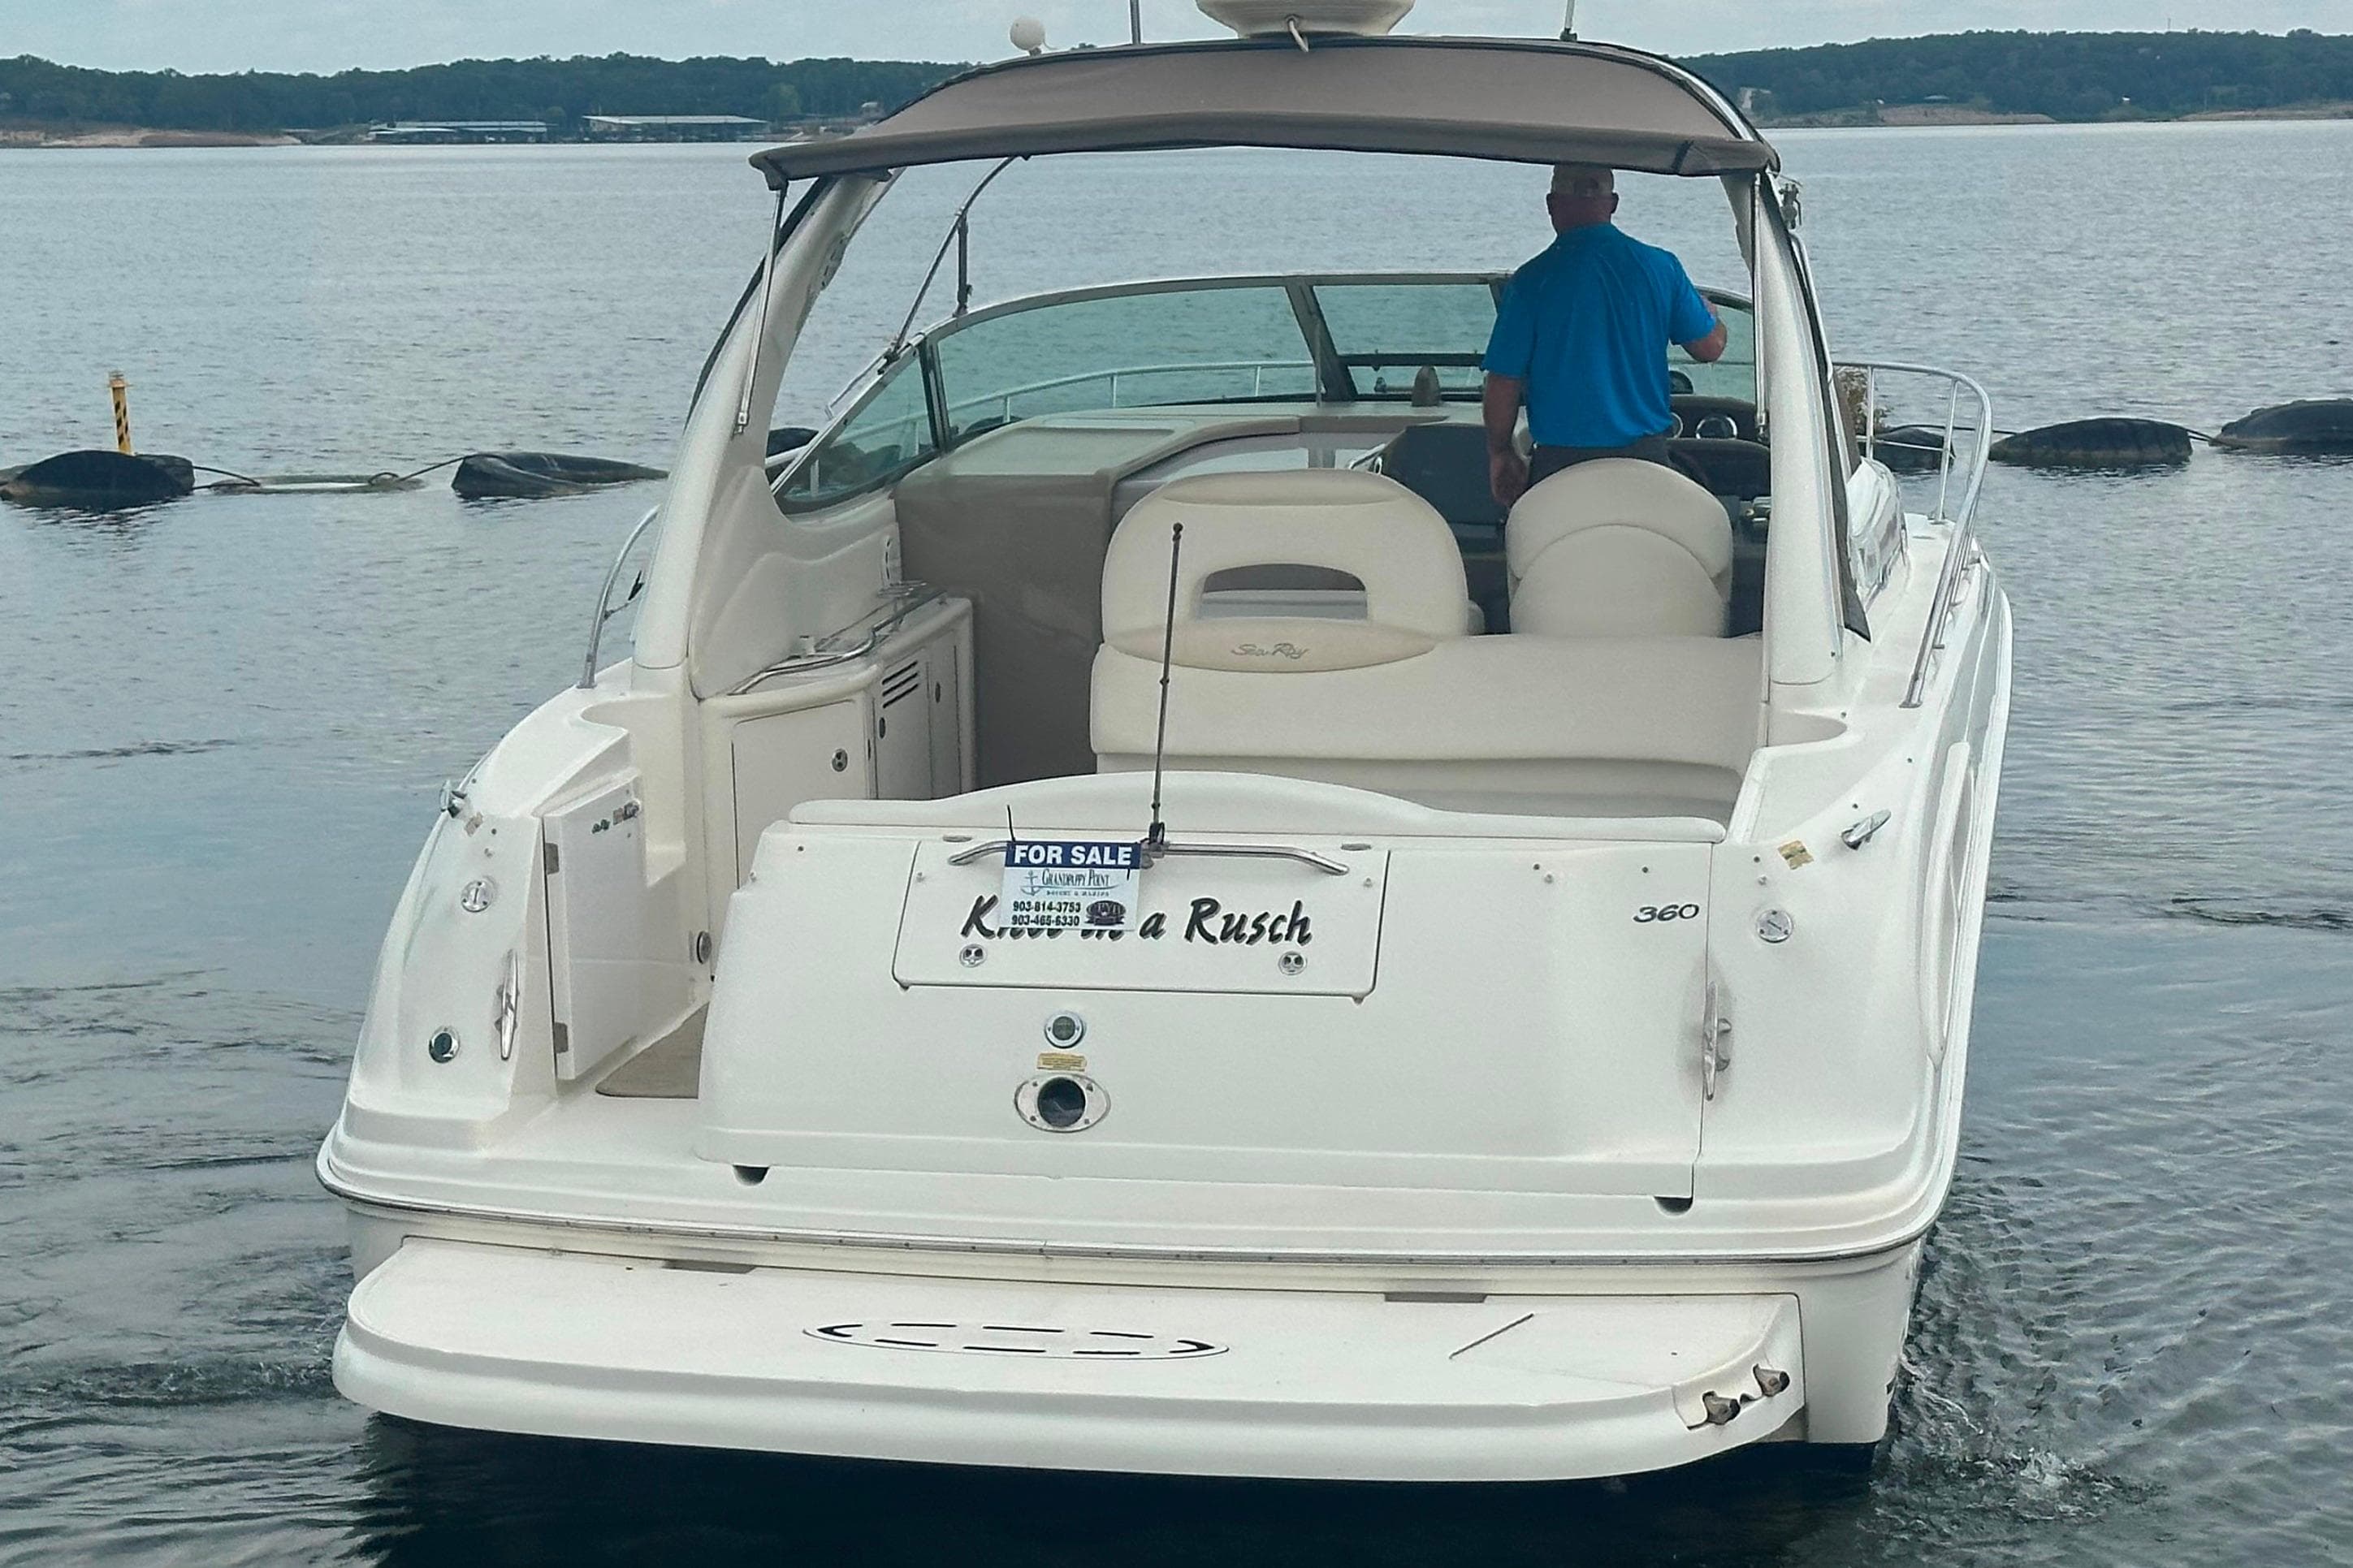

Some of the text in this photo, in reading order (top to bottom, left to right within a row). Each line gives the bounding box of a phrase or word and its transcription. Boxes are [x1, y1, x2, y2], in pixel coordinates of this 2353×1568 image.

[1014, 844, 1133, 866] FOR SALE
[1013, 901, 1081, 913] 903-814-3753
[1633, 904, 1700, 923] 360
[1011, 914, 1080, 927] 903-465-6330
[1139, 897, 1313, 946] a Rusch
